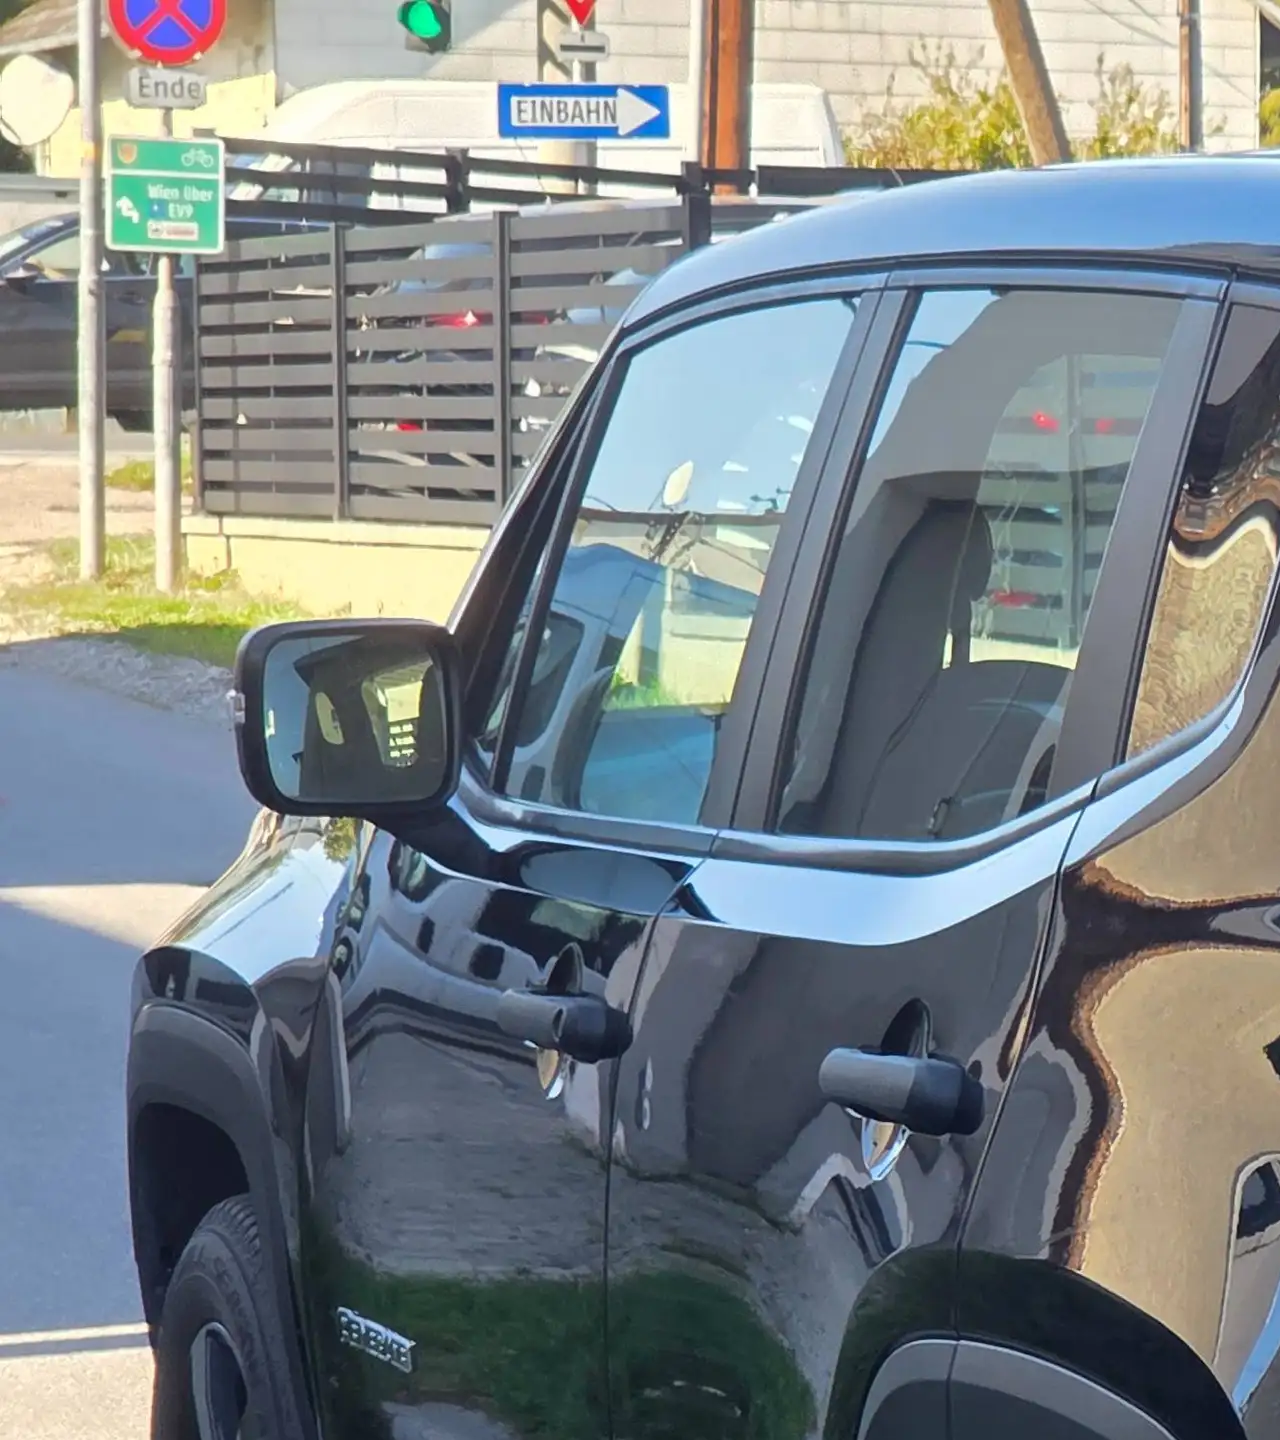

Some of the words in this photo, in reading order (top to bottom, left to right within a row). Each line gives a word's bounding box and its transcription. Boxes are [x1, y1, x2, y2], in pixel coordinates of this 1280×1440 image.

[138, 75, 201, 100] Ende
[516, 99, 617, 124] EINBAHN
[147, 183, 180, 200] Wien
